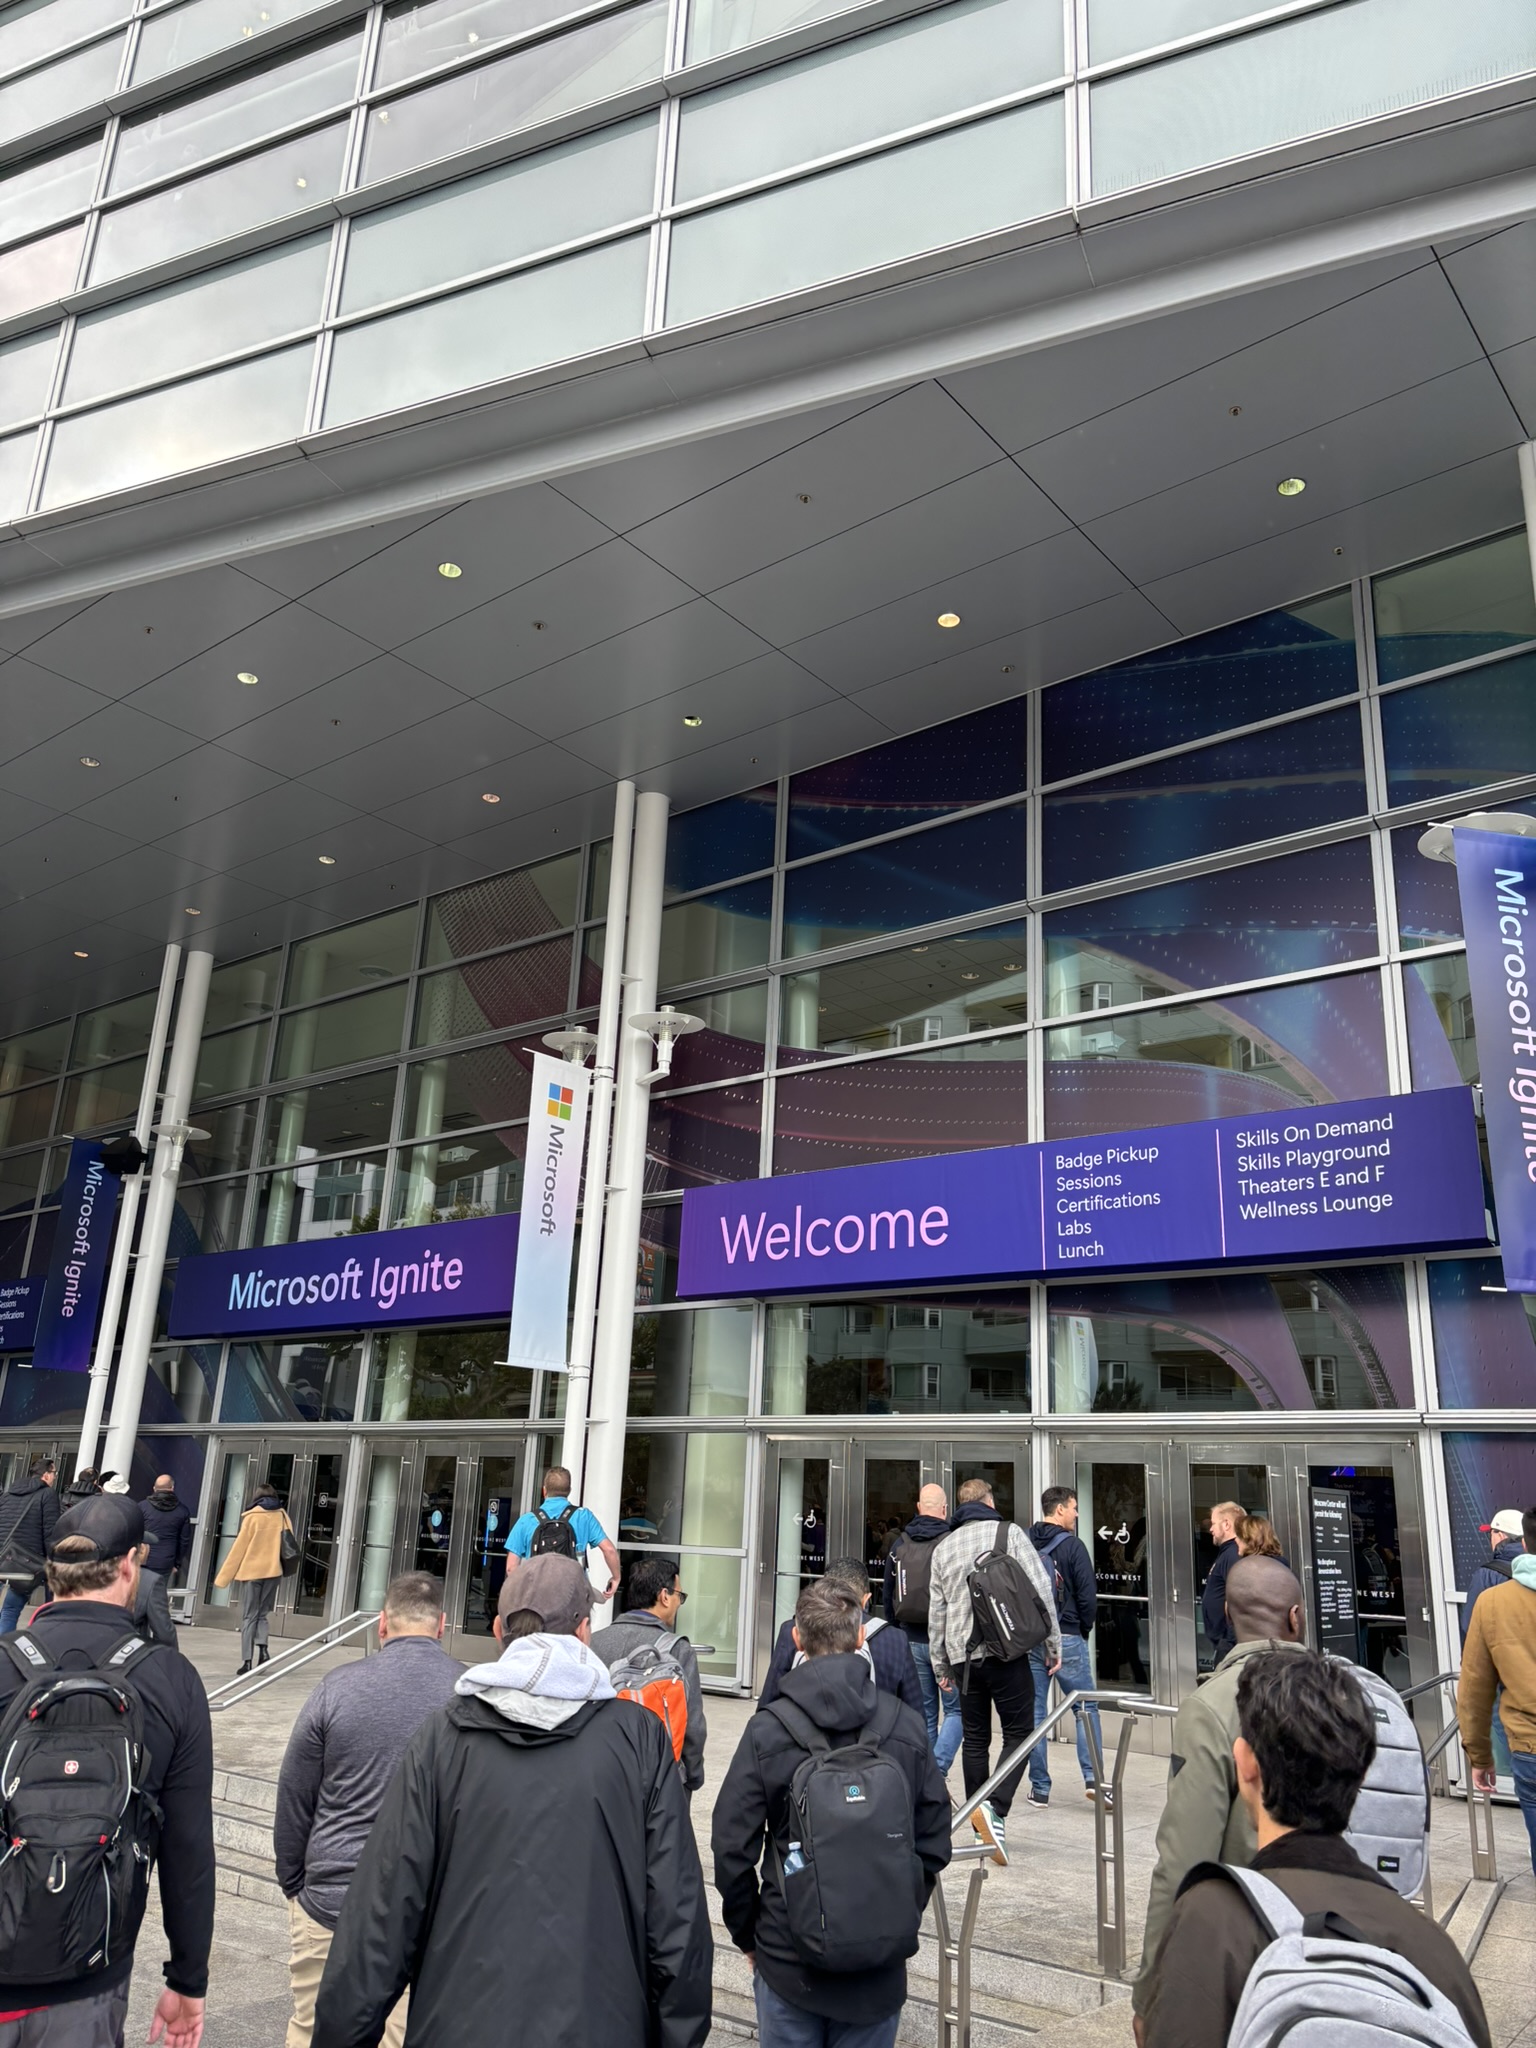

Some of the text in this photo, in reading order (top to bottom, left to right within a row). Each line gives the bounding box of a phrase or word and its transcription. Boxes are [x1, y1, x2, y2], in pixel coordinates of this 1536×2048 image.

[1236, 1112, 1393, 1149] Skills On Demand
[1056, 1146, 1159, 1171] Badge Pickup
[1238, 1138, 1391, 1172] Skills Playground
[540, 1124, 565, 1236] Microsoft
[1056, 1173, 1122, 1191] Sessions
[1238, 1165, 1385, 1196] Theaters E and F
[1056, 1192, 1161, 1214] Certifications
[1239, 1193, 1393, 1220] Wellness Lounge
[61, 1160, 105, 1317] Microsoft Ignite
[720, 1204, 949, 1264] Welcome
[1058, 1219, 1092, 1236] Labs
[1058, 1240, 1104, 1259] Lunch
[15, 1286, 29, 1296] Pickup
[228, 1249, 464, 1310] Microsoft Ignite
[1370, 1590, 1395, 1598] WEST
